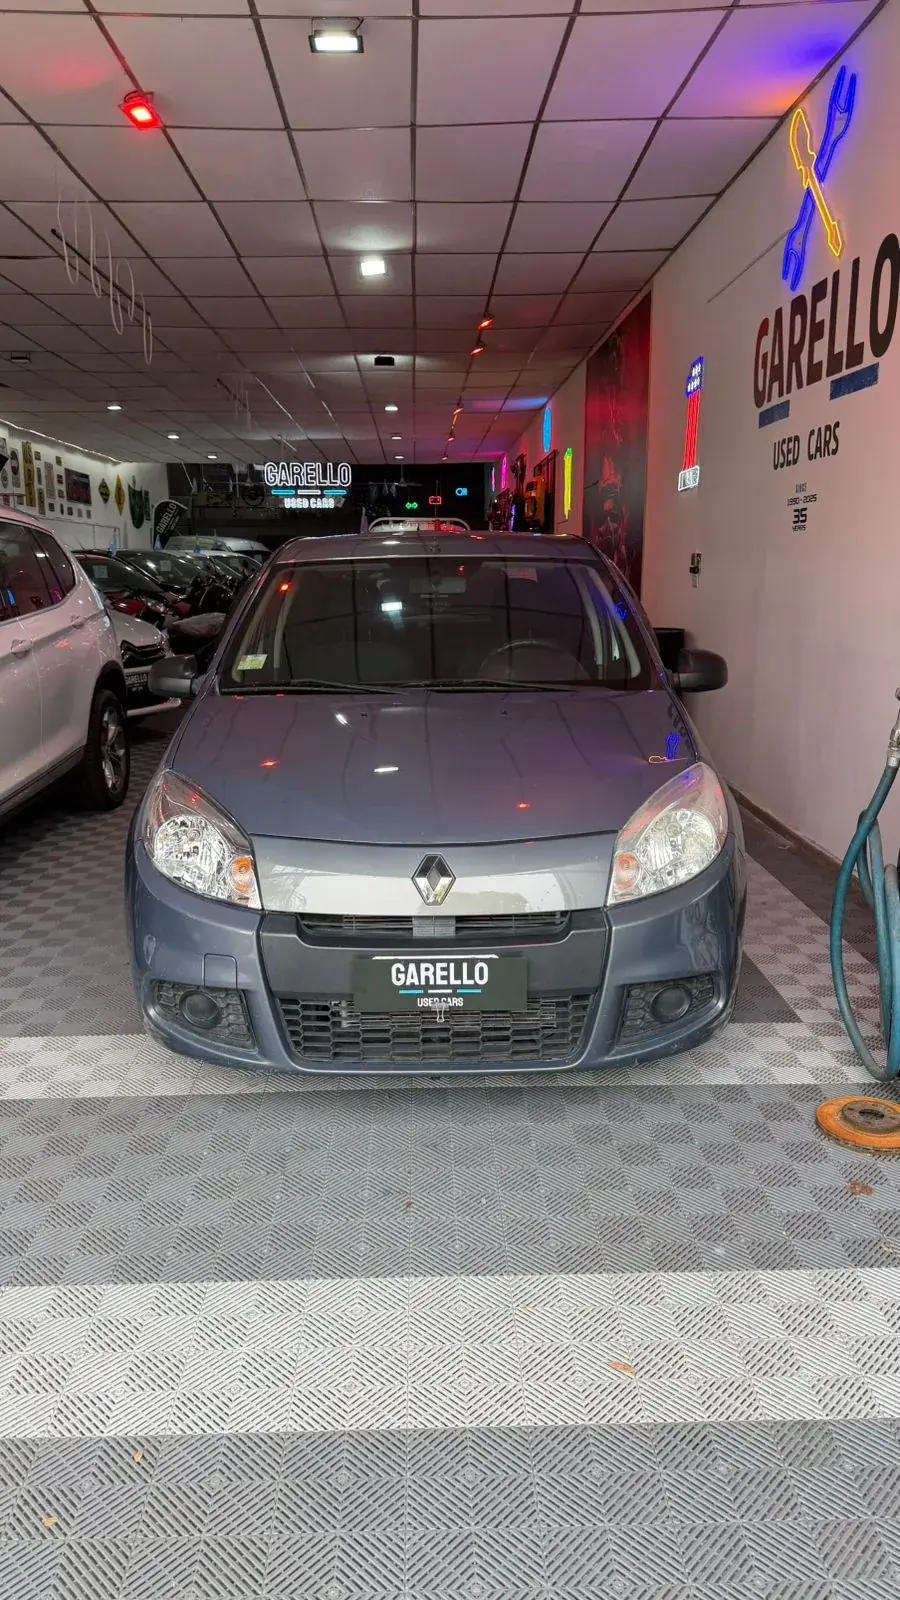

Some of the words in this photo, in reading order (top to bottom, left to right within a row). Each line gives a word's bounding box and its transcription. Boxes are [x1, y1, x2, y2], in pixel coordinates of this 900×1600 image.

[753, 233, 900, 409] GARELLO
[772, 434, 800, 471] USED
[807, 421, 840, 463] CARS
[264, 462, 352, 487] GARELLO
[284, 497, 309, 509] USED
[310, 497, 335, 509] CARS
[792, 507, 808, 524] 35
[156, 502, 177, 534] GARELLO
[391, 962, 489, 986] GARELLO
